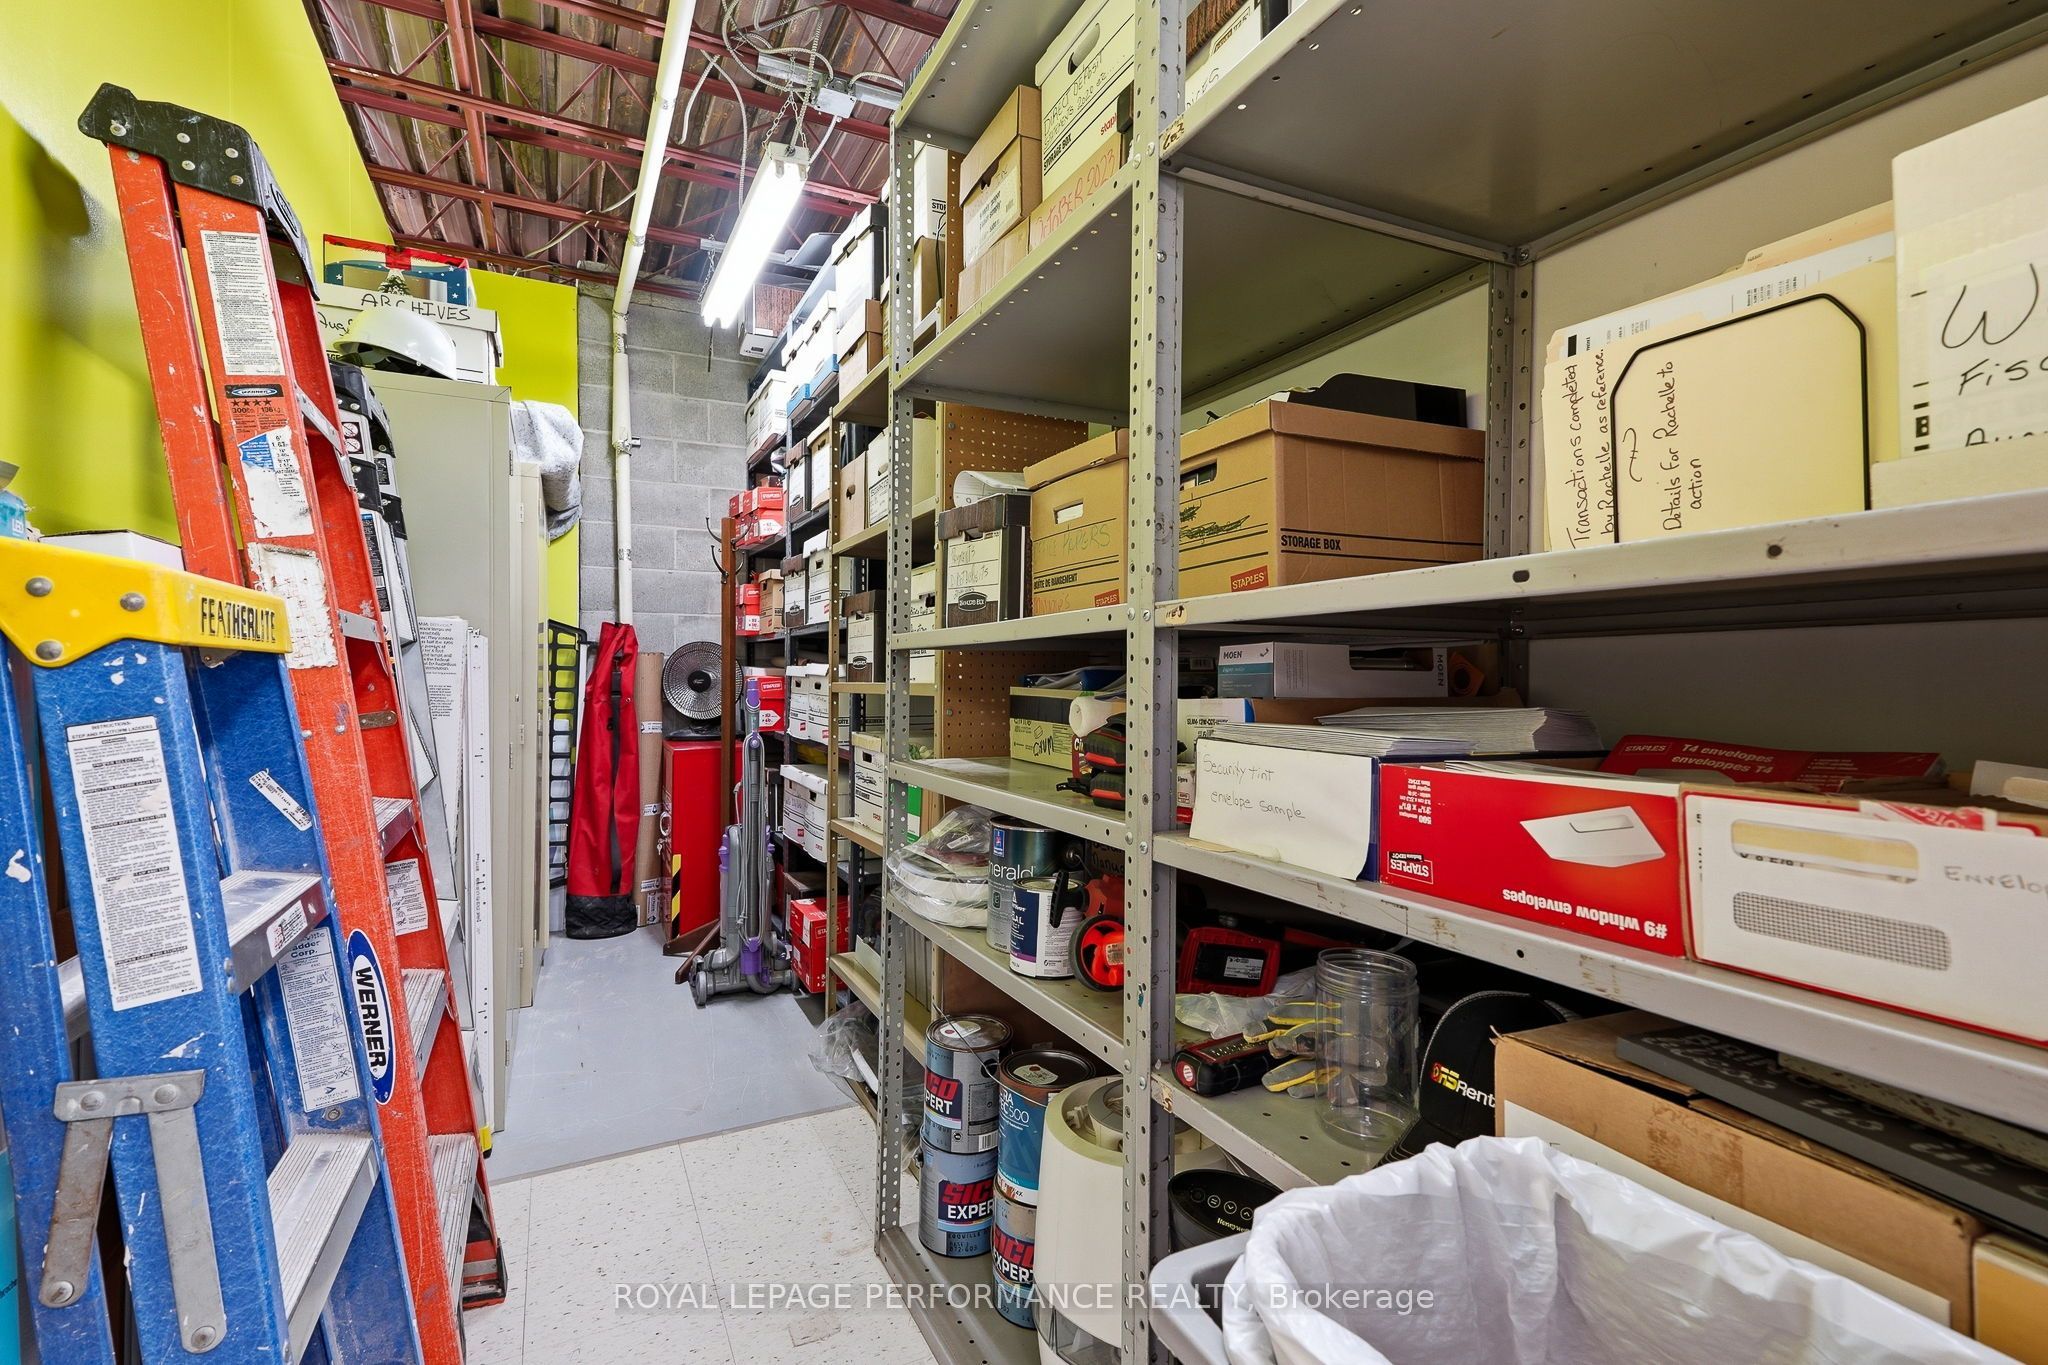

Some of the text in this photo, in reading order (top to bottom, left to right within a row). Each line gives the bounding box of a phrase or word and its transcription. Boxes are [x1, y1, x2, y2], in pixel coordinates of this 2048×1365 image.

[1100, 113, 1117, 136] stapl
[1043, 132, 1072, 172] STORAGE BOX
[1941, 263, 2039, 349] W
[1599, 416, 1609, 433] as
[1562, 364, 1591, 549] Transactions completed
[1652, 361, 1683, 531] Details for Rachelle to
[1595, 441, 1615, 510] Rachelle
[1687, 458, 1703, 510] action
[1600, 513, 1615, 535] by
[1281, 535, 1341, 551] STORAGE BOX
[1232, 572, 1265, 590] STAPLES
[1095, 593, 1118, 607] STAPLES
[201, 597, 276, 644] FEATHERLITE
[1223, 650, 1243, 660] MOEN
[1437, 654, 1446, 687] MOEN
[1625, 743, 1775, 764] STAPLES T4 envelopes
[1203, 753, 1275, 785] Security tint
[1671, 755, 1775, 775] enveloppes T4
[1210, 790, 1253, 811] envelope
[1418, 815, 1432, 825] 500
[1390, 859, 1429, 877] STAPLES
[1502, 888, 1668, 939] #9 window envelopes
[355, 966, 387, 1070] WERNER
[1217, 1217, 1250, 1233] Honeywe
